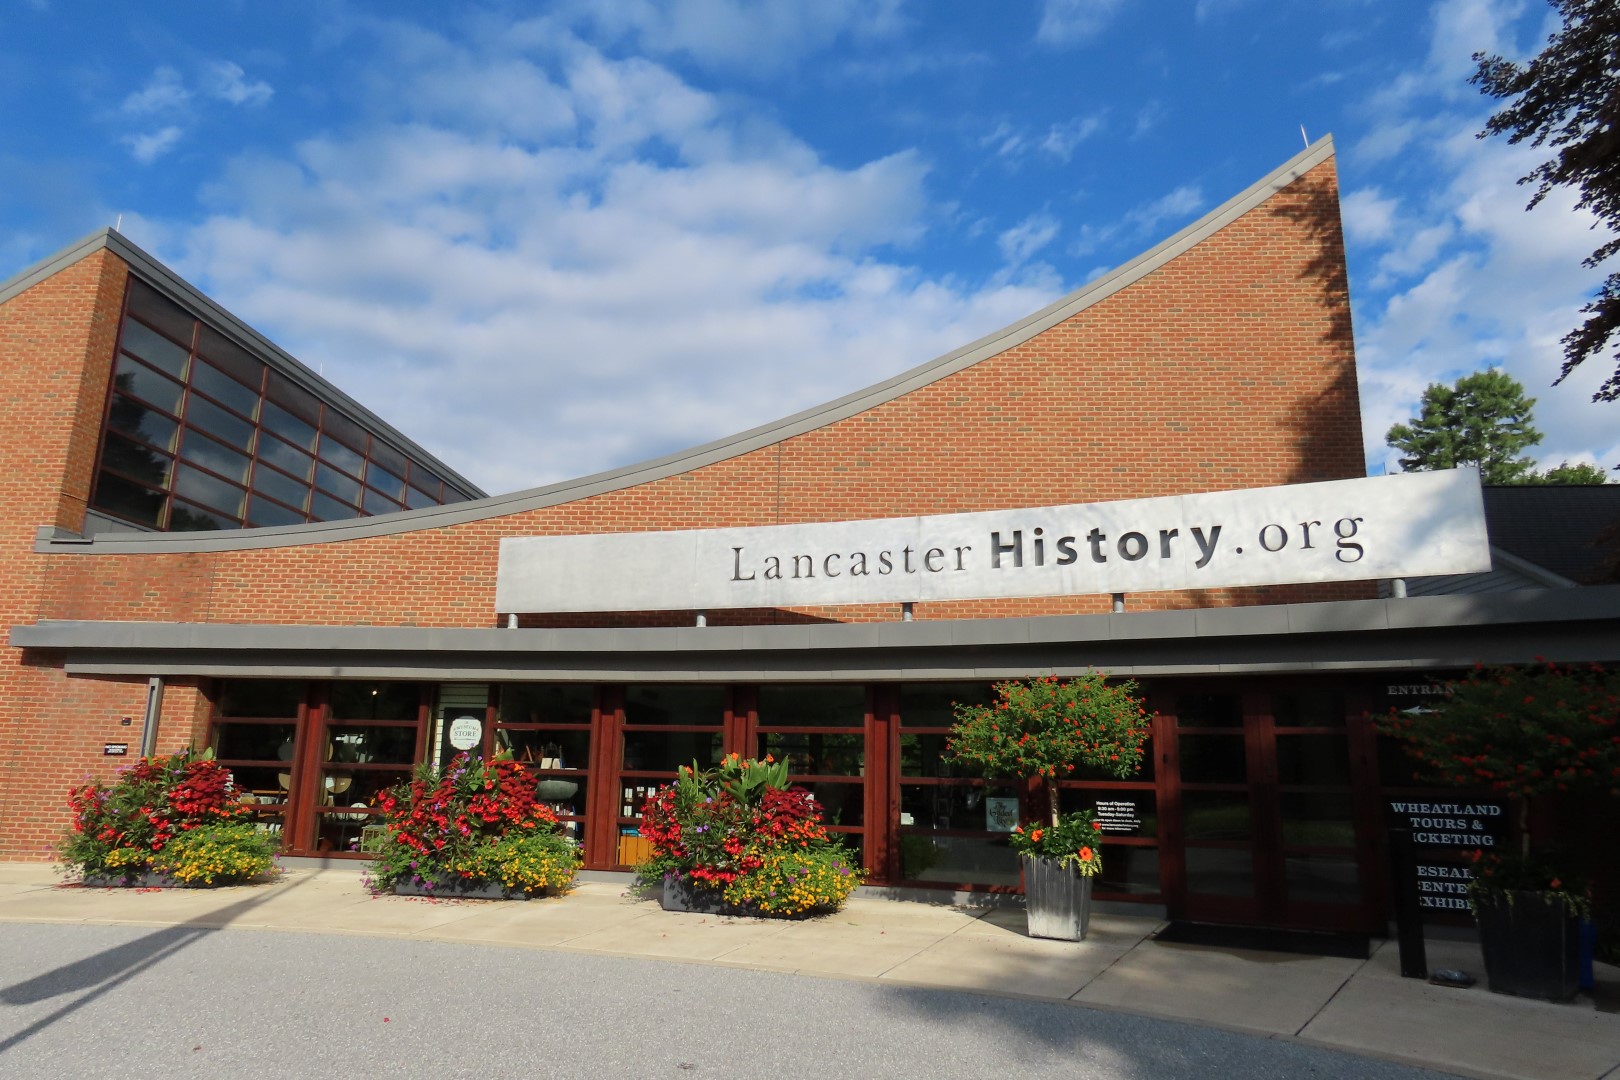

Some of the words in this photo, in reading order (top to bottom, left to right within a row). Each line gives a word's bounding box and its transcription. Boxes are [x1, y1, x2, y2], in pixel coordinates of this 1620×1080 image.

[1390, 802, 1501, 816] WHEATLAND
[1409, 817, 1467, 829] TOURS
[1471, 819, 1484, 830] &
[1413, 832, 1494, 846] ICKETING
[1416, 865, 1475, 879] ESEAR
[1417, 880, 1468, 894] ENTE
